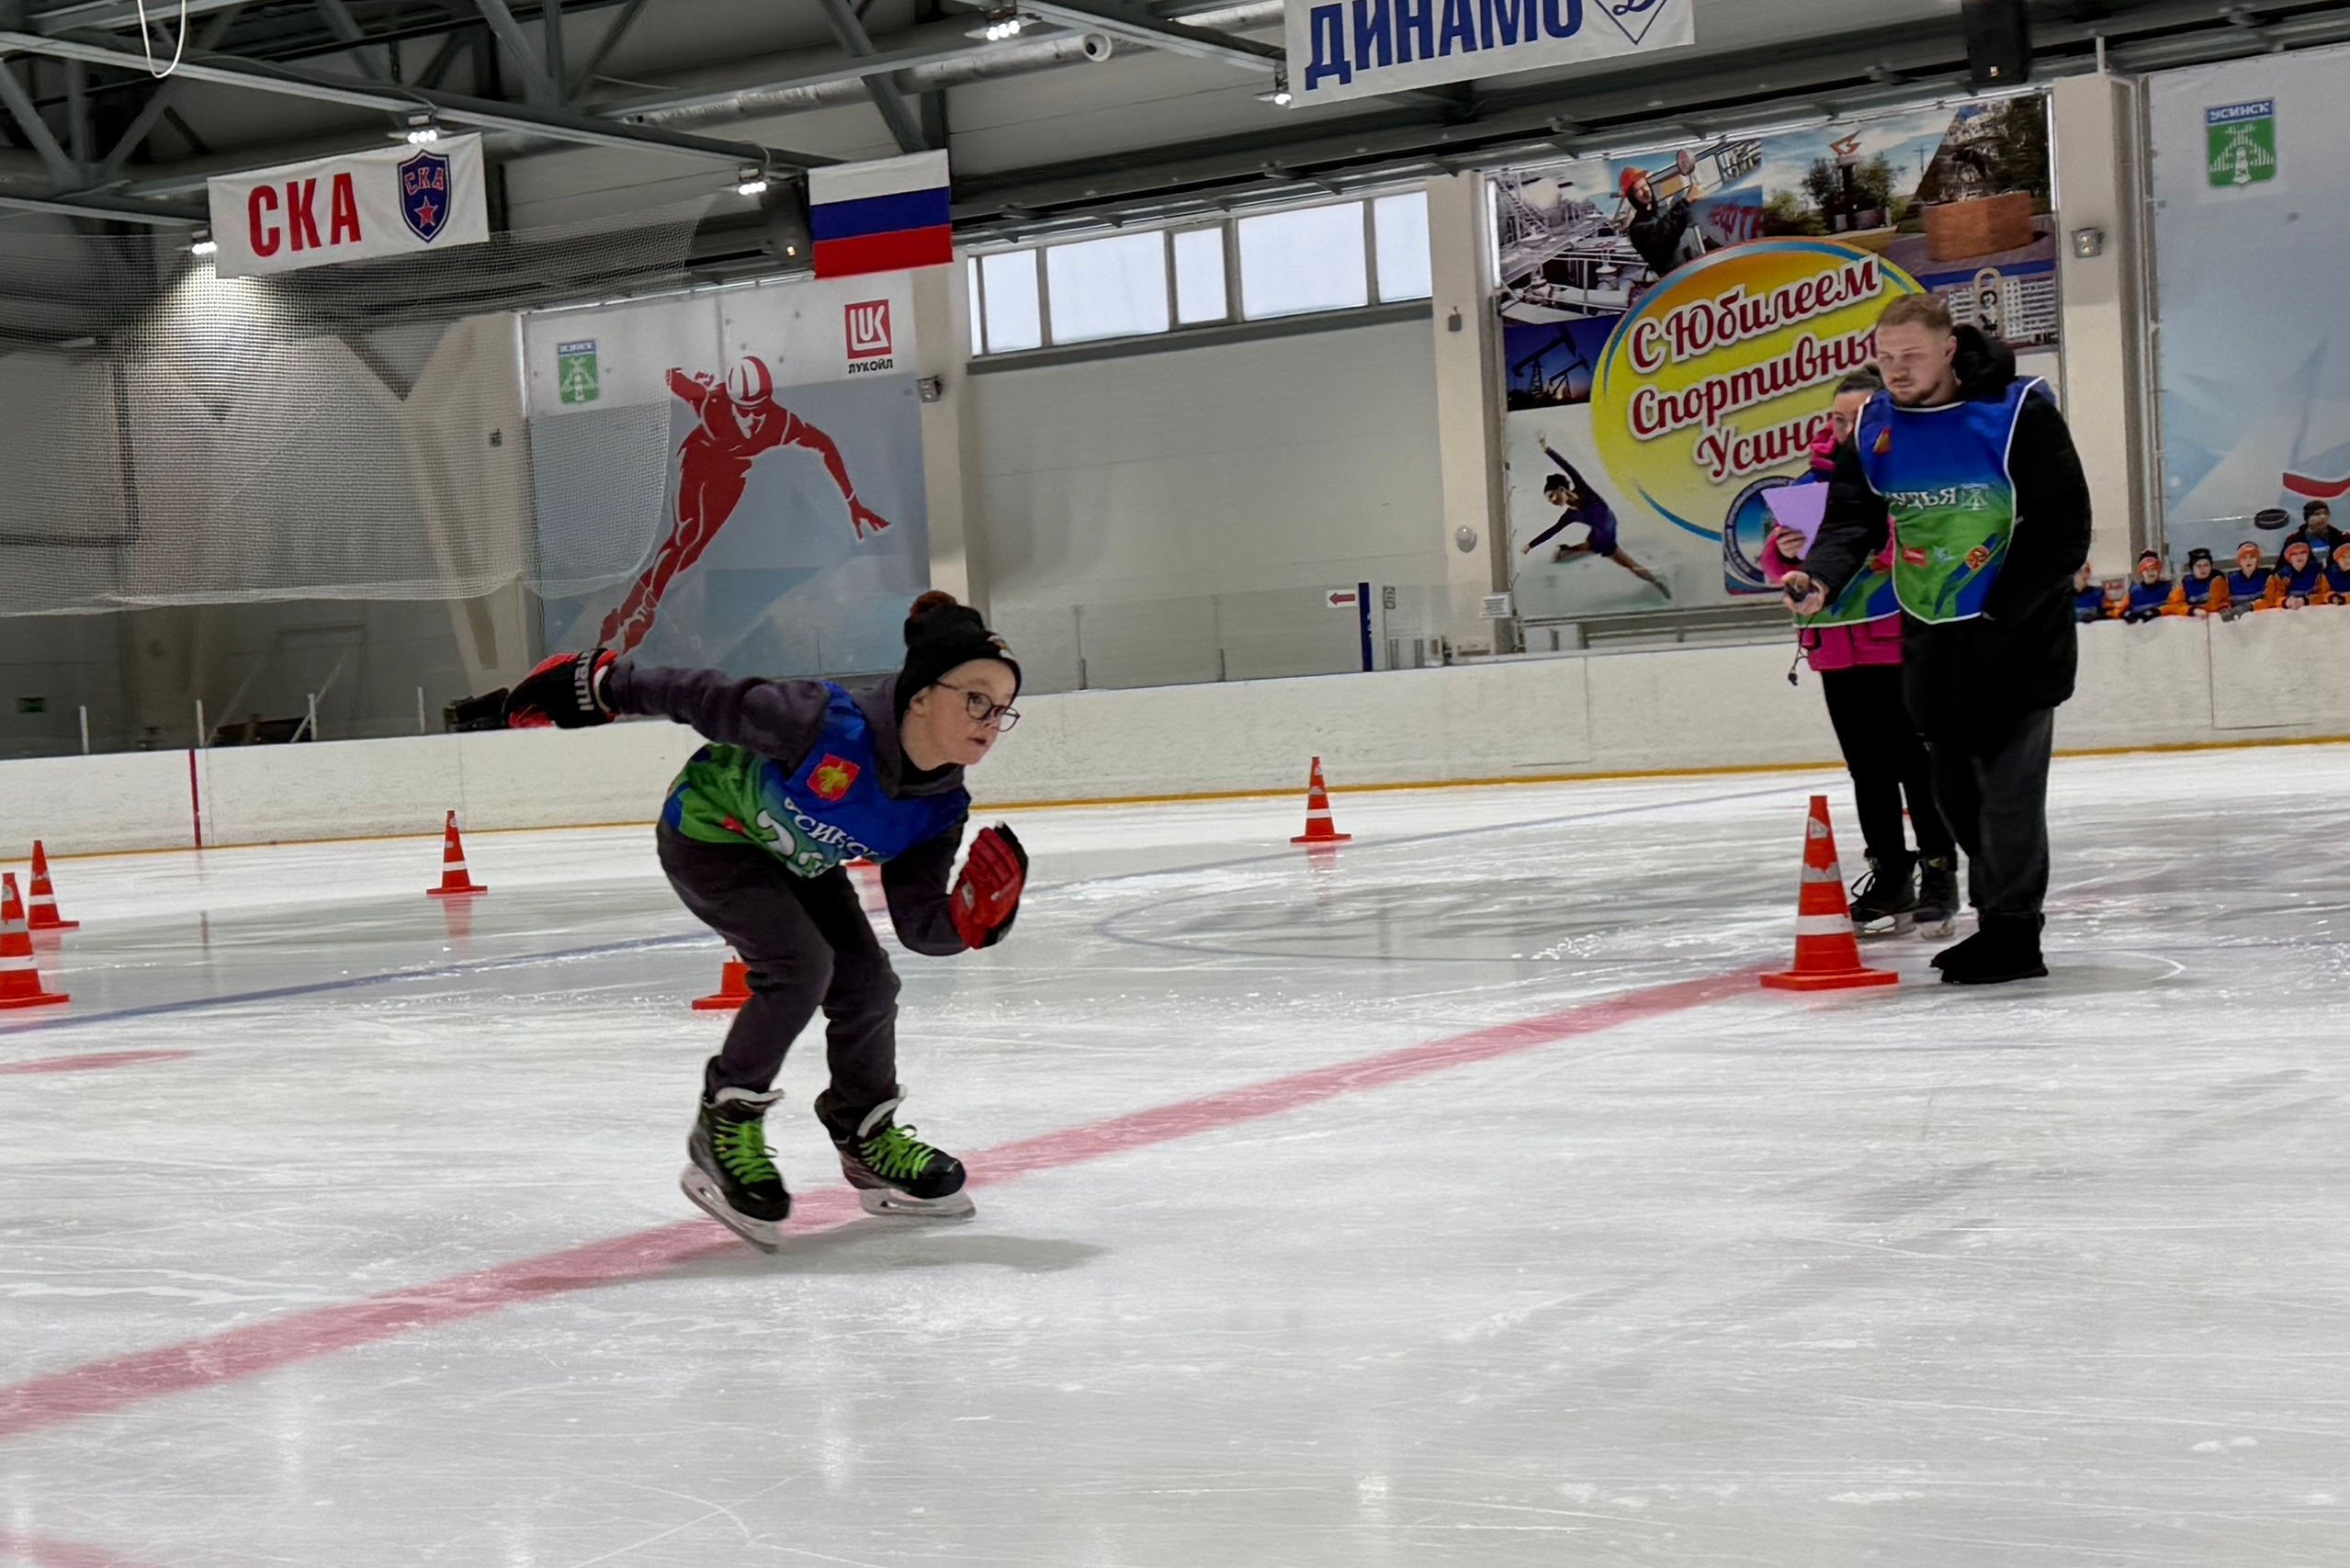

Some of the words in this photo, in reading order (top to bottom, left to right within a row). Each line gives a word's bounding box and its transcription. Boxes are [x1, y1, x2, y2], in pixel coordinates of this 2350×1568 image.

[2209, 101, 2270, 121] УСИНСК
[403, 166, 445, 196] СКА
[248, 172, 362, 258] СКА
[1632, 321, 1662, 368] С
[1664, 259, 1879, 357] Юбилеем
[847, 357, 894, 375] ЛУКОЙЛ
[1632, 329, 1878, 436] Спортивны
[1696, 412, 1834, 479] Усинс
[1885, 486, 1957, 510] УДЬЯ
